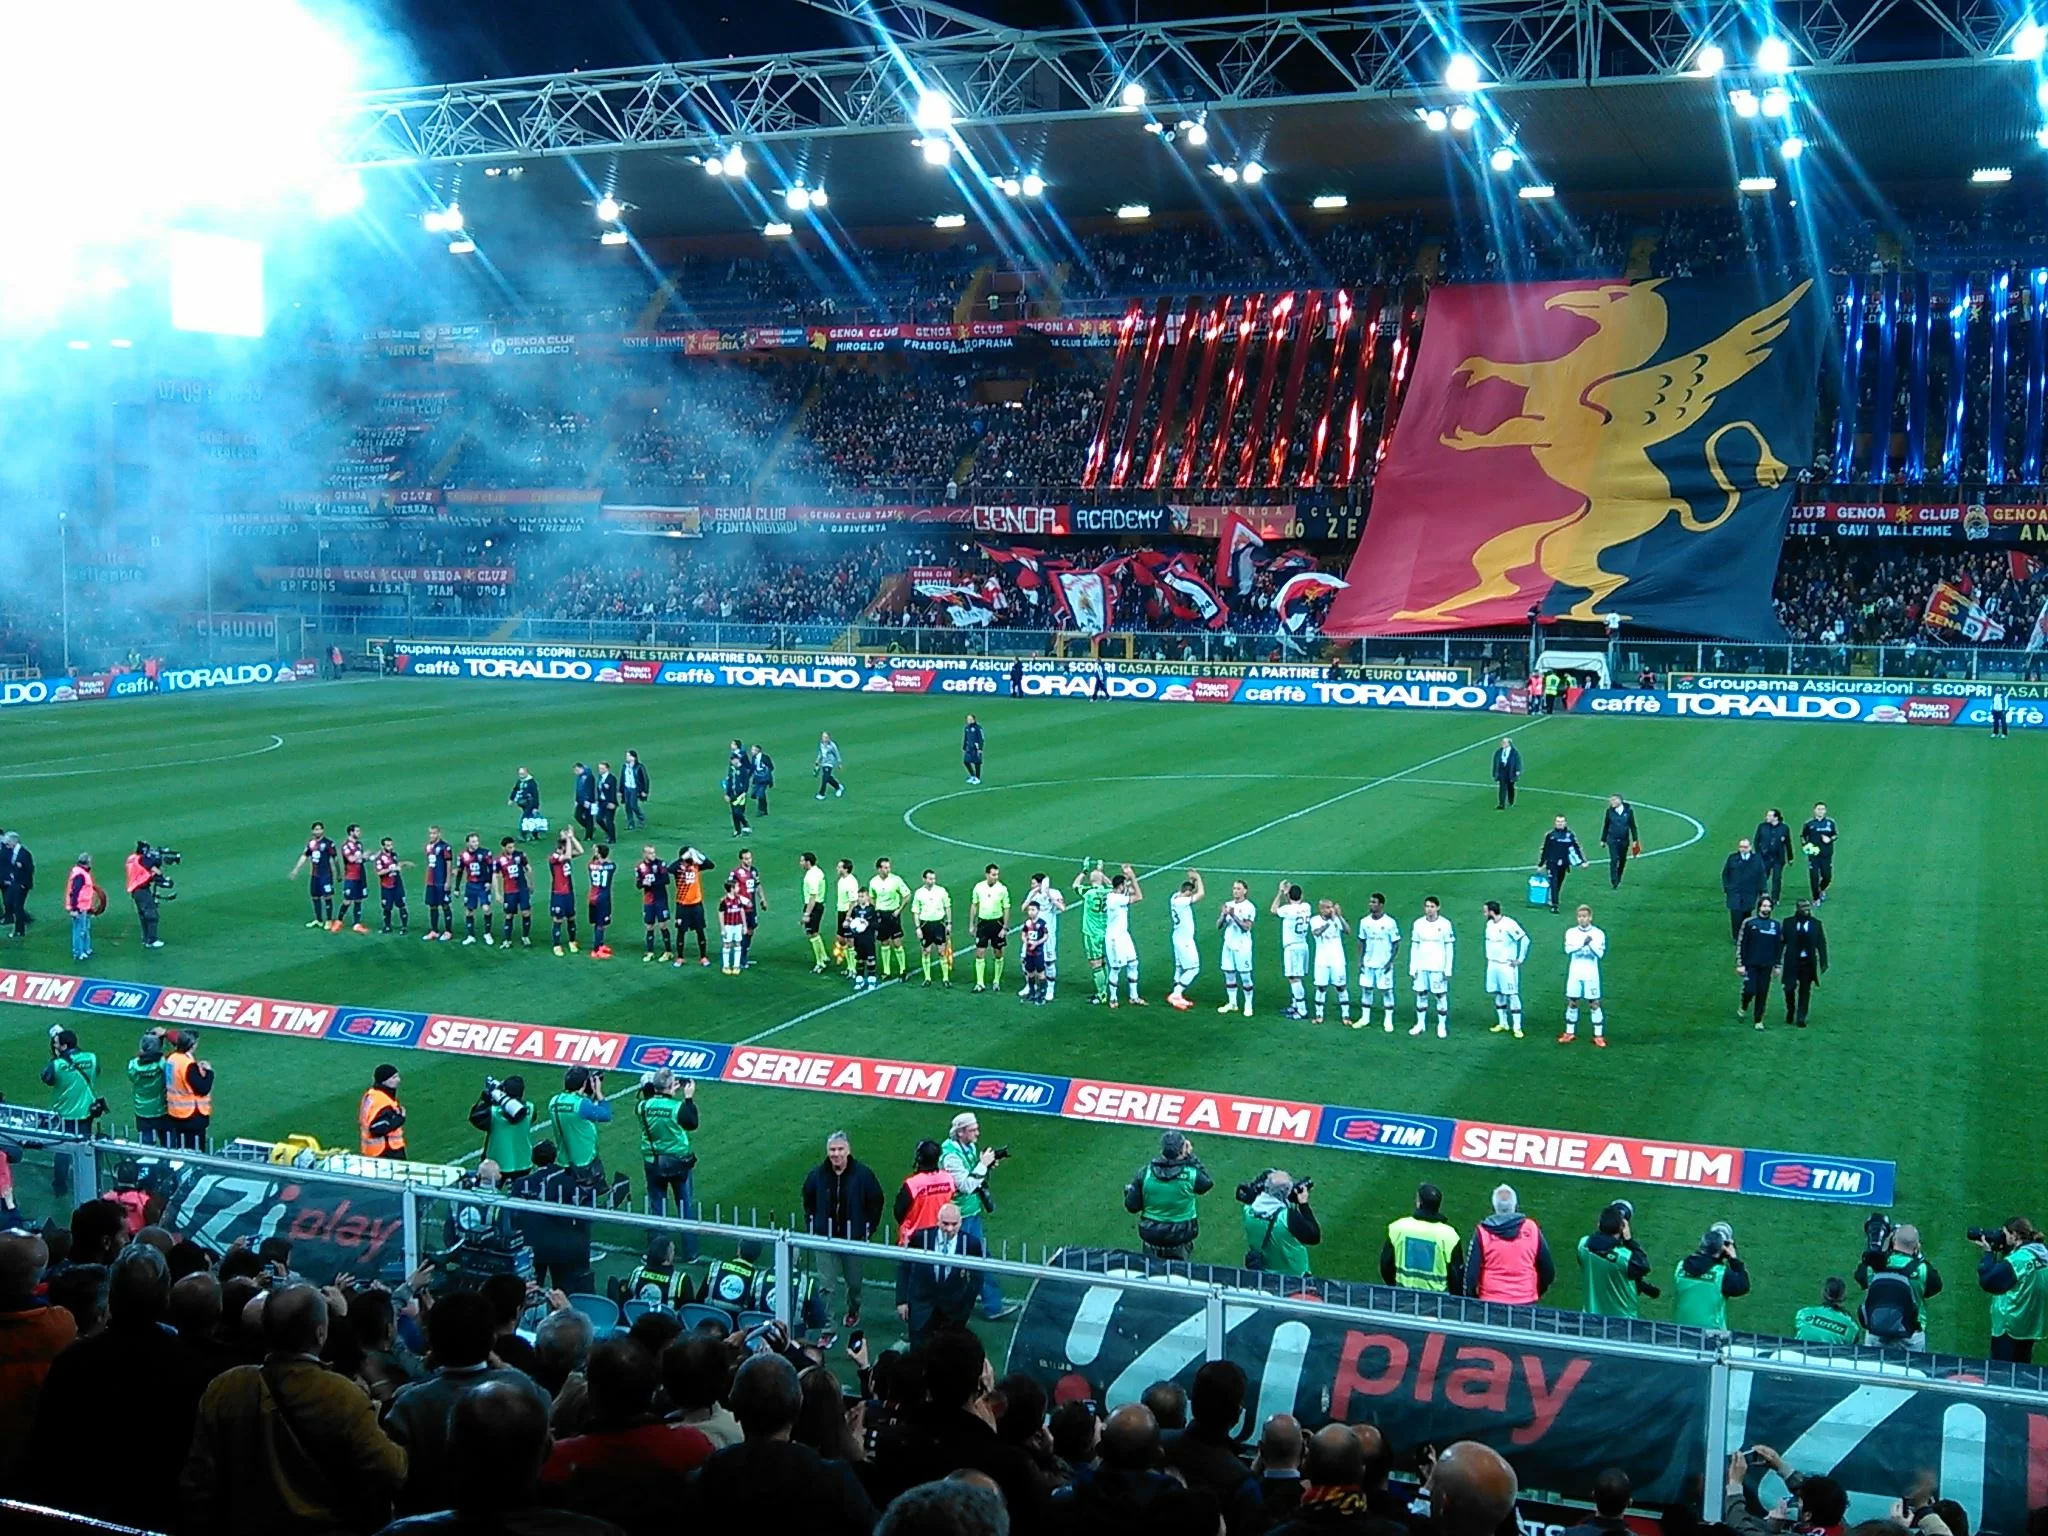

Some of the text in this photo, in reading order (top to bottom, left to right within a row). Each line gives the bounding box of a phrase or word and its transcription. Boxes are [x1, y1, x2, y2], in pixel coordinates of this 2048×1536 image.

[830, 326, 898, 338] GENOA CLUB
[915, 324, 1004, 337] GENOA CLUB
[715, 507, 786, 521] GENOA CLUB
[810, 510, 841, 520] GENOA
[846, 511, 871, 520] CLUB
[973, 506, 1057, 534] GENOA
[1076, 509, 1164, 530] ACADEMY
[1221, 506, 1362, 517] GENOA CLUB
[1792, 506, 2048, 521] LUB GENOA CLUB GENOA
[1837, 523, 1869, 536] GAVI
[1877, 525, 1952, 537] VALLEMME
[343, 569, 376, 580] GENOA
[423, 569, 462, 581] GENOA
[477, 570, 508, 581] CLUB
[197, 620, 274, 638] CLAUDIO
[395, 644, 450, 656] roupama
[453, 643, 525, 658] Assicurazioni
[536, 646, 576, 658] SCOPRI
[578, 648, 607, 659] CASA
[649, 651, 685, 662] START
[686, 652, 695, 662] A
[697, 652, 745, 664] PARTIRE
[746, 653, 764, 664] DA
[765, 653, 779, 664] 70
[781, 653, 813, 665] EURO
[814, 654, 857, 667] L'ANNO
[162, 663, 273, 692] TORALDO
[414, 658, 593, 681] caffè TORALDO
[664, 665, 861, 689] caffè TORALDO
[890, 656, 967, 671] Groupama
[1118, 663, 1152, 674] CASA
[1154, 664, 1200, 676] FACILE
[1201, 666, 1246, 677] START
[1249, 666, 1259, 677] A
[1260, 667, 1320, 679] PARTIRE
[1406, 670, 1458, 683] L'ANNO
[942, 675, 997, 694] caffè
[1195, 688, 1229, 698] NAPOLI
[1245, 681, 1487, 708] caffè TORALDO
[1698, 677, 1799, 692] Groupama
[1802, 679, 1914, 695] Assicurazioni
[1932, 684, 1993, 698] SCOPRI
[2001, 686, 2040, 698] ASA
[1591, 692, 1861, 719] caffè TORALDO
[1908, 709, 1949, 719] NAPOLI
[591, 870, 609, 888] 91
[1294, 916, 1311, 934] 25
[22, 976, 75, 1003] TIM
[110, 991, 143, 1009] TIM
[158, 993, 330, 1034] SERIE A TIM
[370, 1019, 406, 1039] TIM
[426, 1019, 619, 1065] SERIE A TIM
[667, 1049, 706, 1070] TIM
[732, 1052, 946, 1098] SERIE A TIM
[1001, 1083, 1044, 1104] TIM
[1073, 1085, 1312, 1138] SERIE A TIM
[1377, 1124, 1426, 1147] TIM
[1461, 1128, 1735, 1184] SERIE A TIM
[1810, 1170, 1863, 1193] TIM
[289, 1199, 402, 1264] play
[1814, 1317, 1846, 1335] lotto
[1328, 1328, 1592, 1446] play
